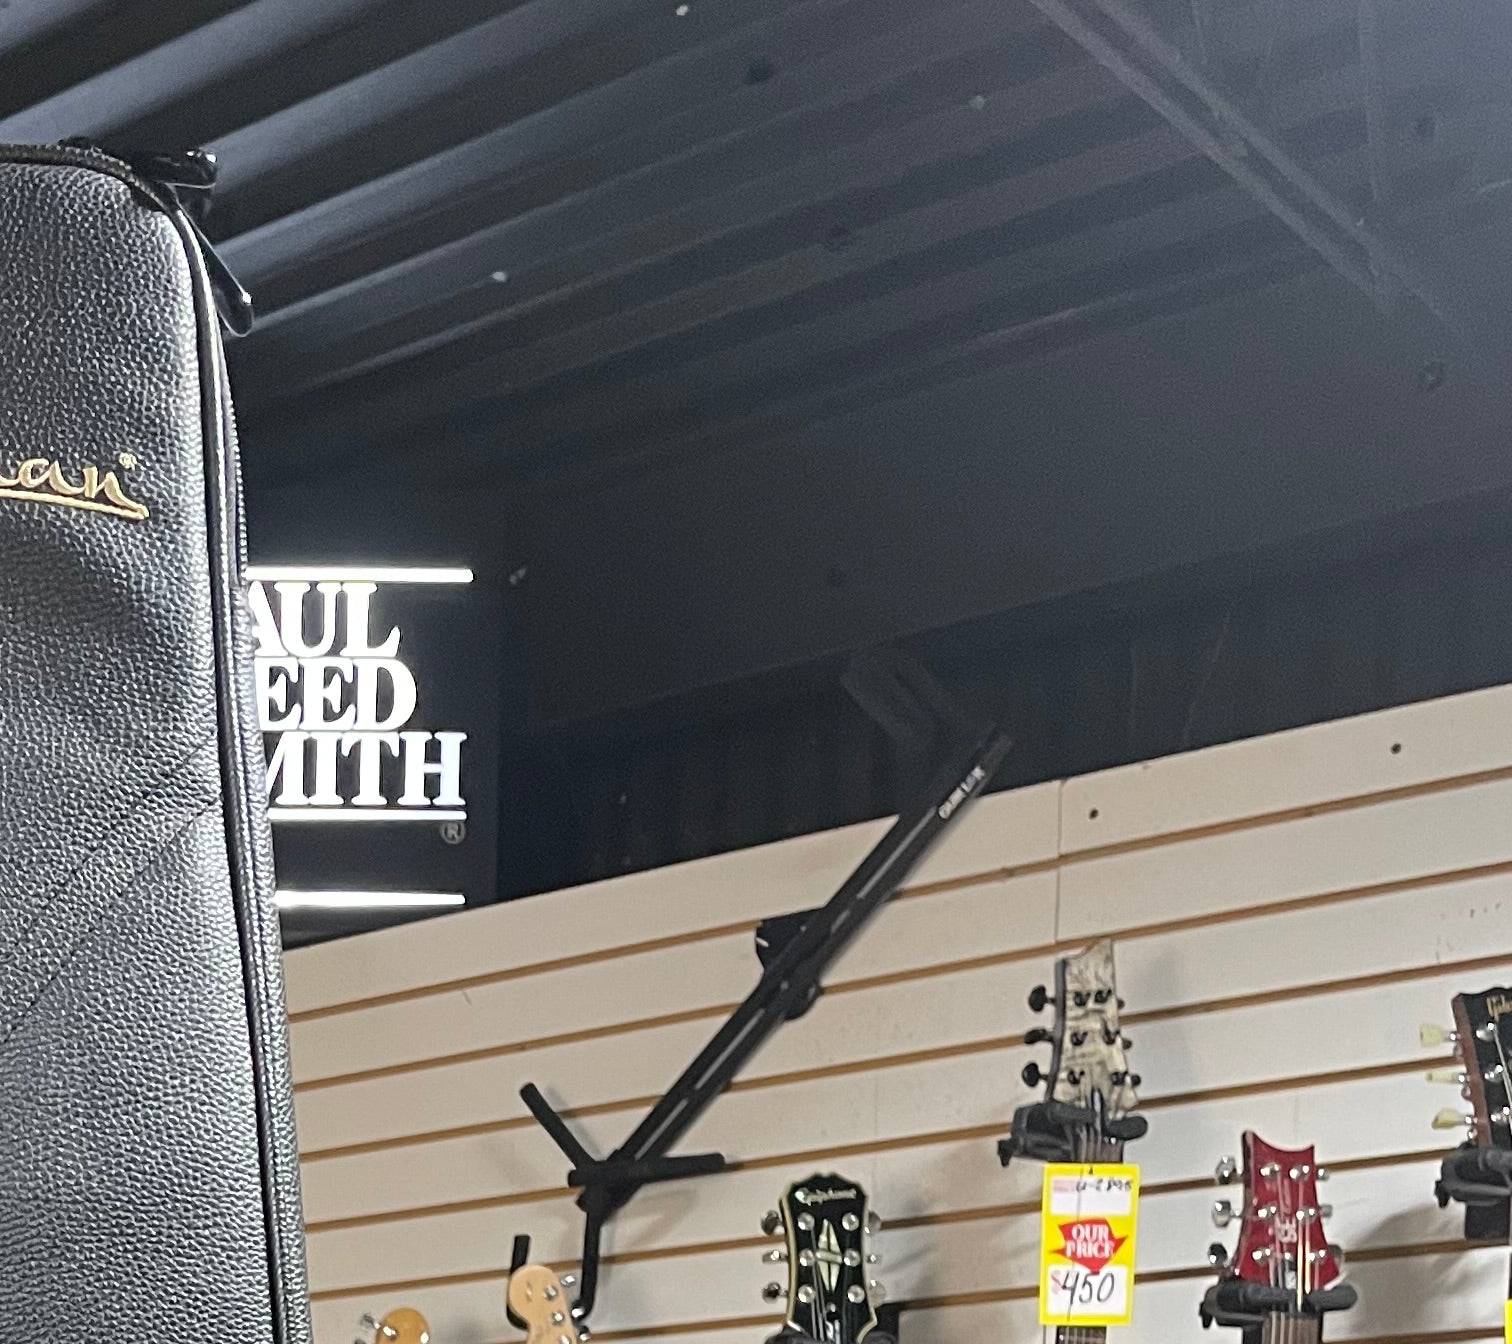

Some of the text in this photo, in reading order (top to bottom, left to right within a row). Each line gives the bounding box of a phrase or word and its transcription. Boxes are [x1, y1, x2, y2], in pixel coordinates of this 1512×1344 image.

[248, 581, 401, 657] AUL
[254, 656, 417, 732] EED
[263, 730, 468, 806] MITH
[1065, 1239, 1115, 1258] PRICE
[1072, 1223, 1109, 1241] OUR
